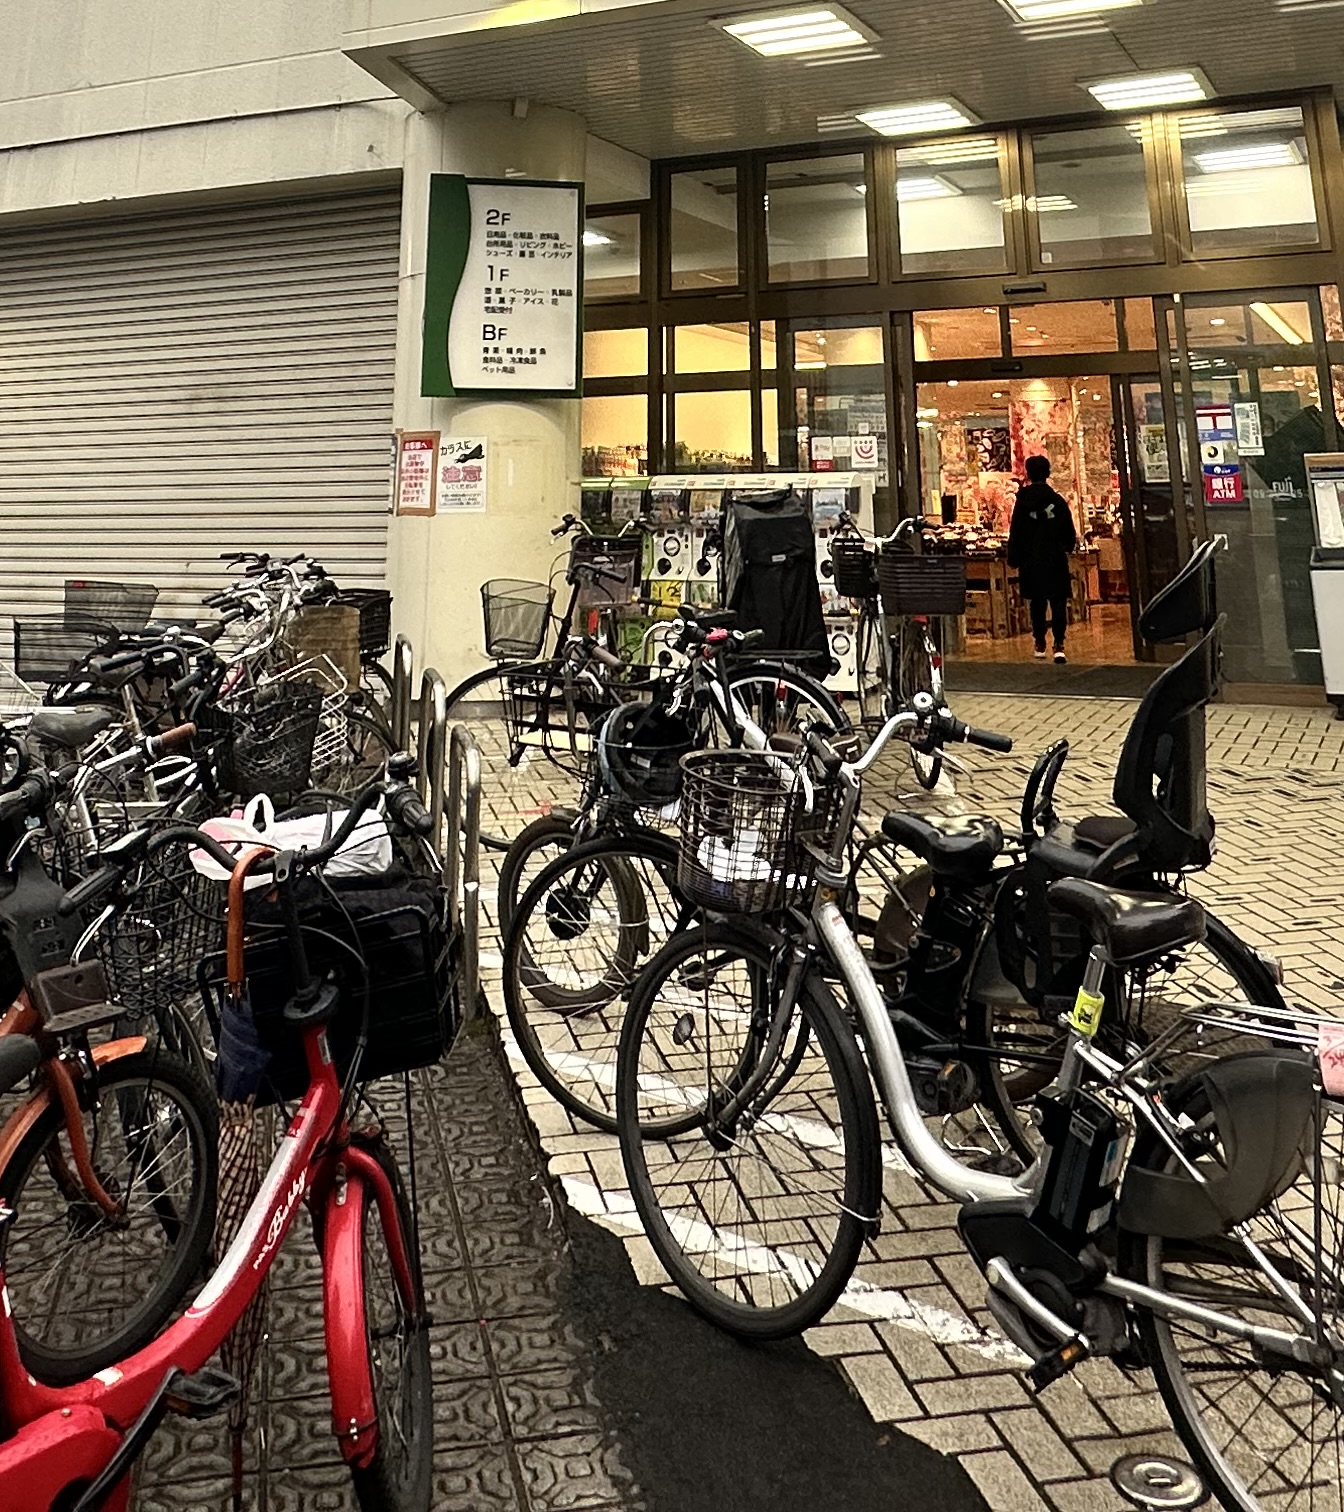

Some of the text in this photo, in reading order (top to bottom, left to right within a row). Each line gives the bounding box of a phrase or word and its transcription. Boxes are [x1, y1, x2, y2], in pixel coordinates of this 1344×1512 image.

[486, 209, 511, 225] 2F
[488, 265, 509, 281] 1F
[483, 324, 508, 340] BF
[440, 440, 472, 456] カラスに
[441, 465, 483, 483] 注意
[1213, 490, 1236, 498] ATM
